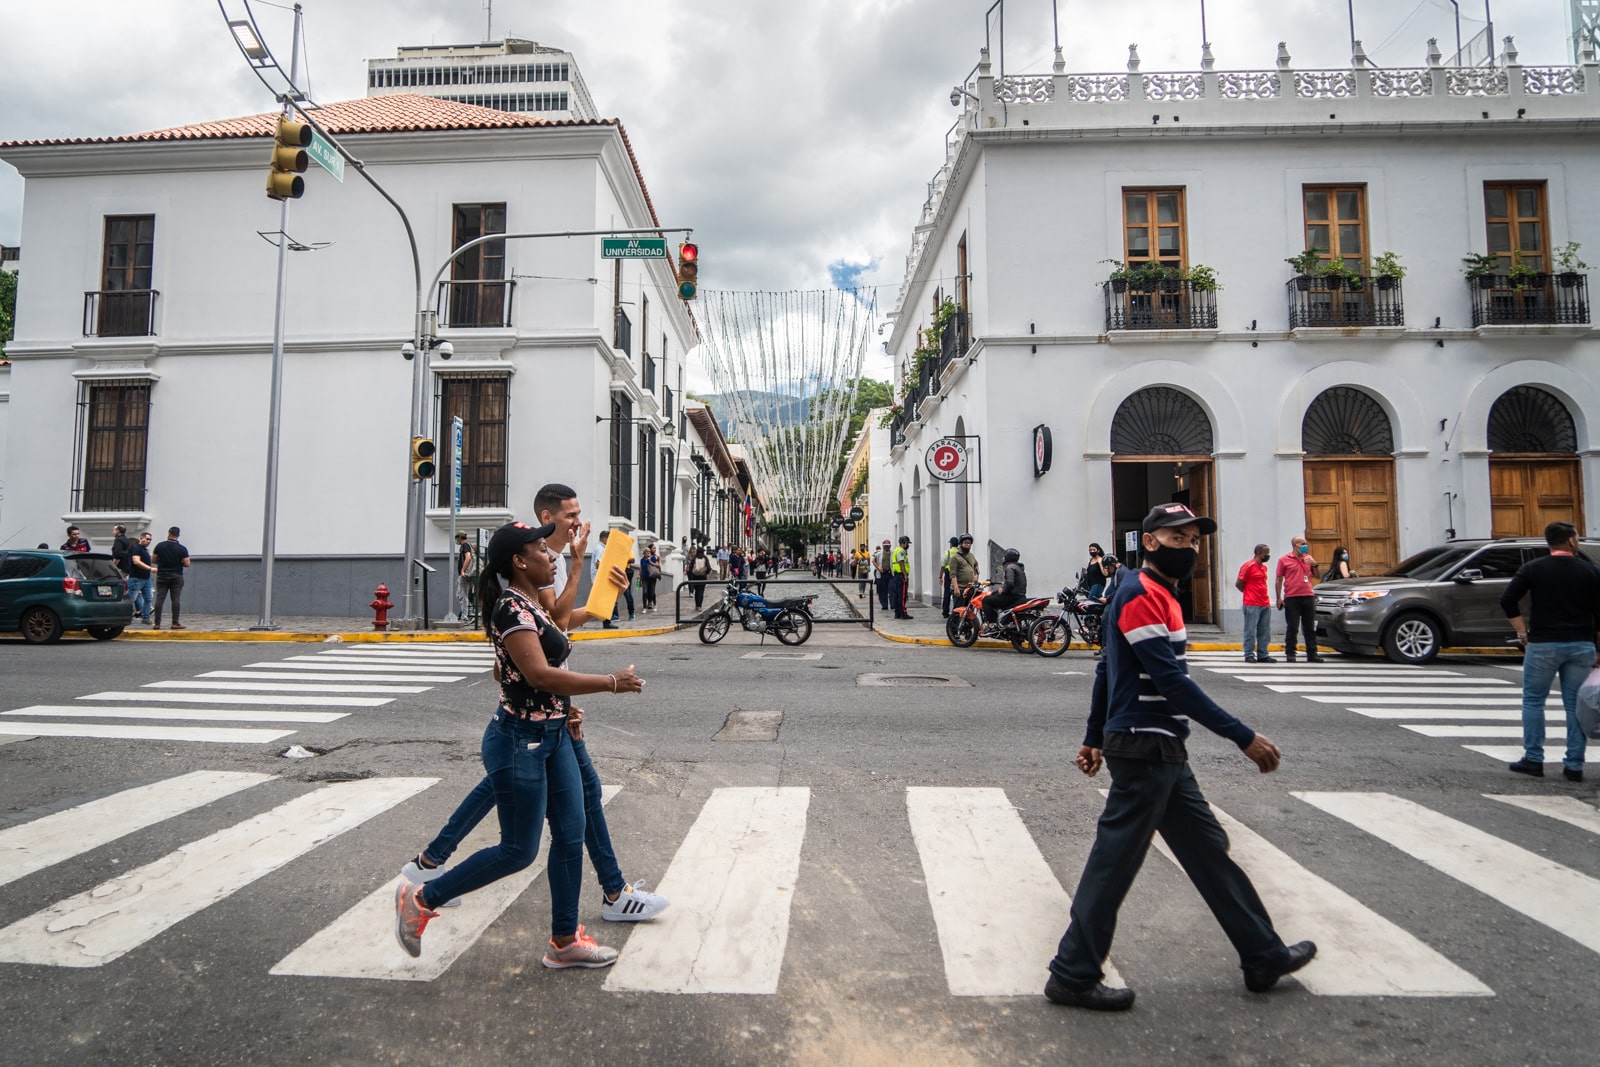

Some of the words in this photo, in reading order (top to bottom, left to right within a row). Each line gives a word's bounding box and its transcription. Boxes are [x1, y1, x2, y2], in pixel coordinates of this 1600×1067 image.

[312, 140, 323, 157] AV.
[323, 149, 336, 168] SUR
[627, 240, 640, 248] AV.
[605, 248, 663, 256] UNIVERSIDAD
[931, 440, 963, 453] PARAMO
